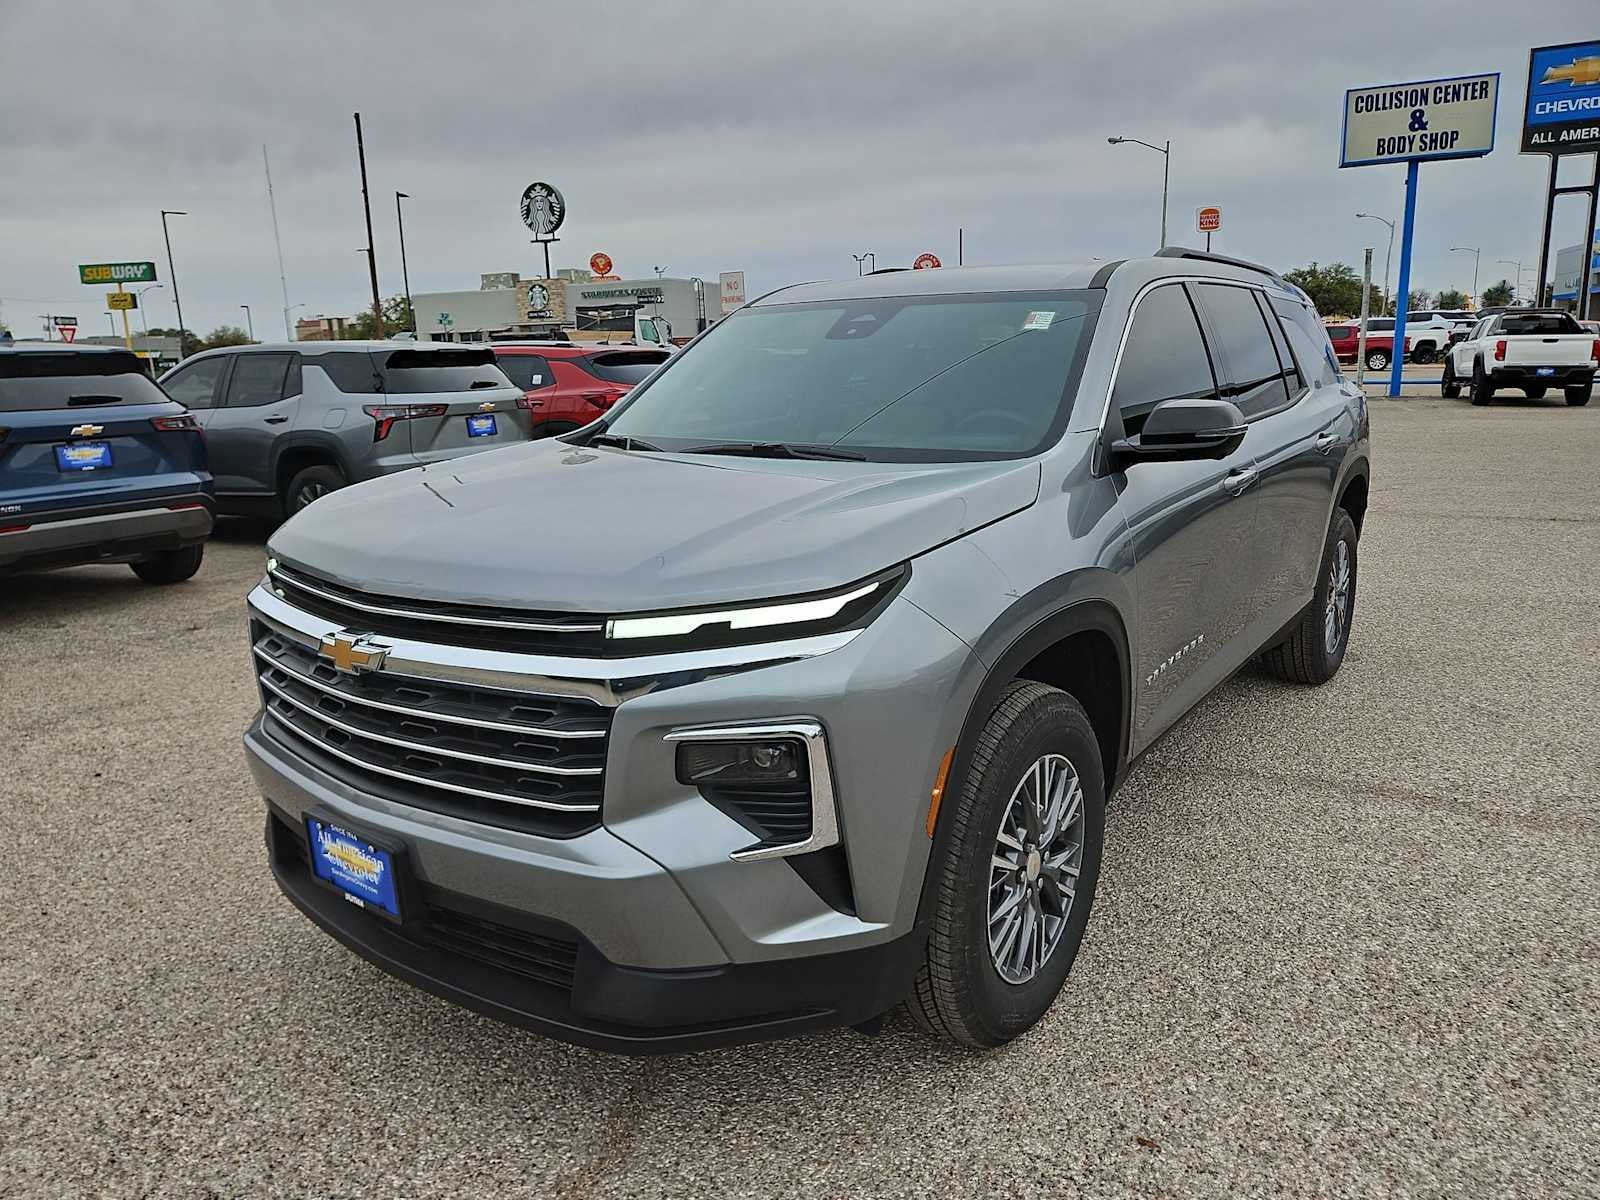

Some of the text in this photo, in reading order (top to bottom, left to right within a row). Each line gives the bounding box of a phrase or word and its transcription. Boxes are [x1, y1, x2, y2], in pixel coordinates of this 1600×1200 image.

[1354, 80, 1489, 113] COLLISION CENTER
[1408, 108, 1428, 132] &
[1376, 130, 1459, 156] BODY SHOP
[1530, 131, 1556, 144] ALL
[83, 264, 147, 280] SUBWAY
[726, 280, 738, 290] NO
[1145, 634, 1204, 685] TRAVERSE
